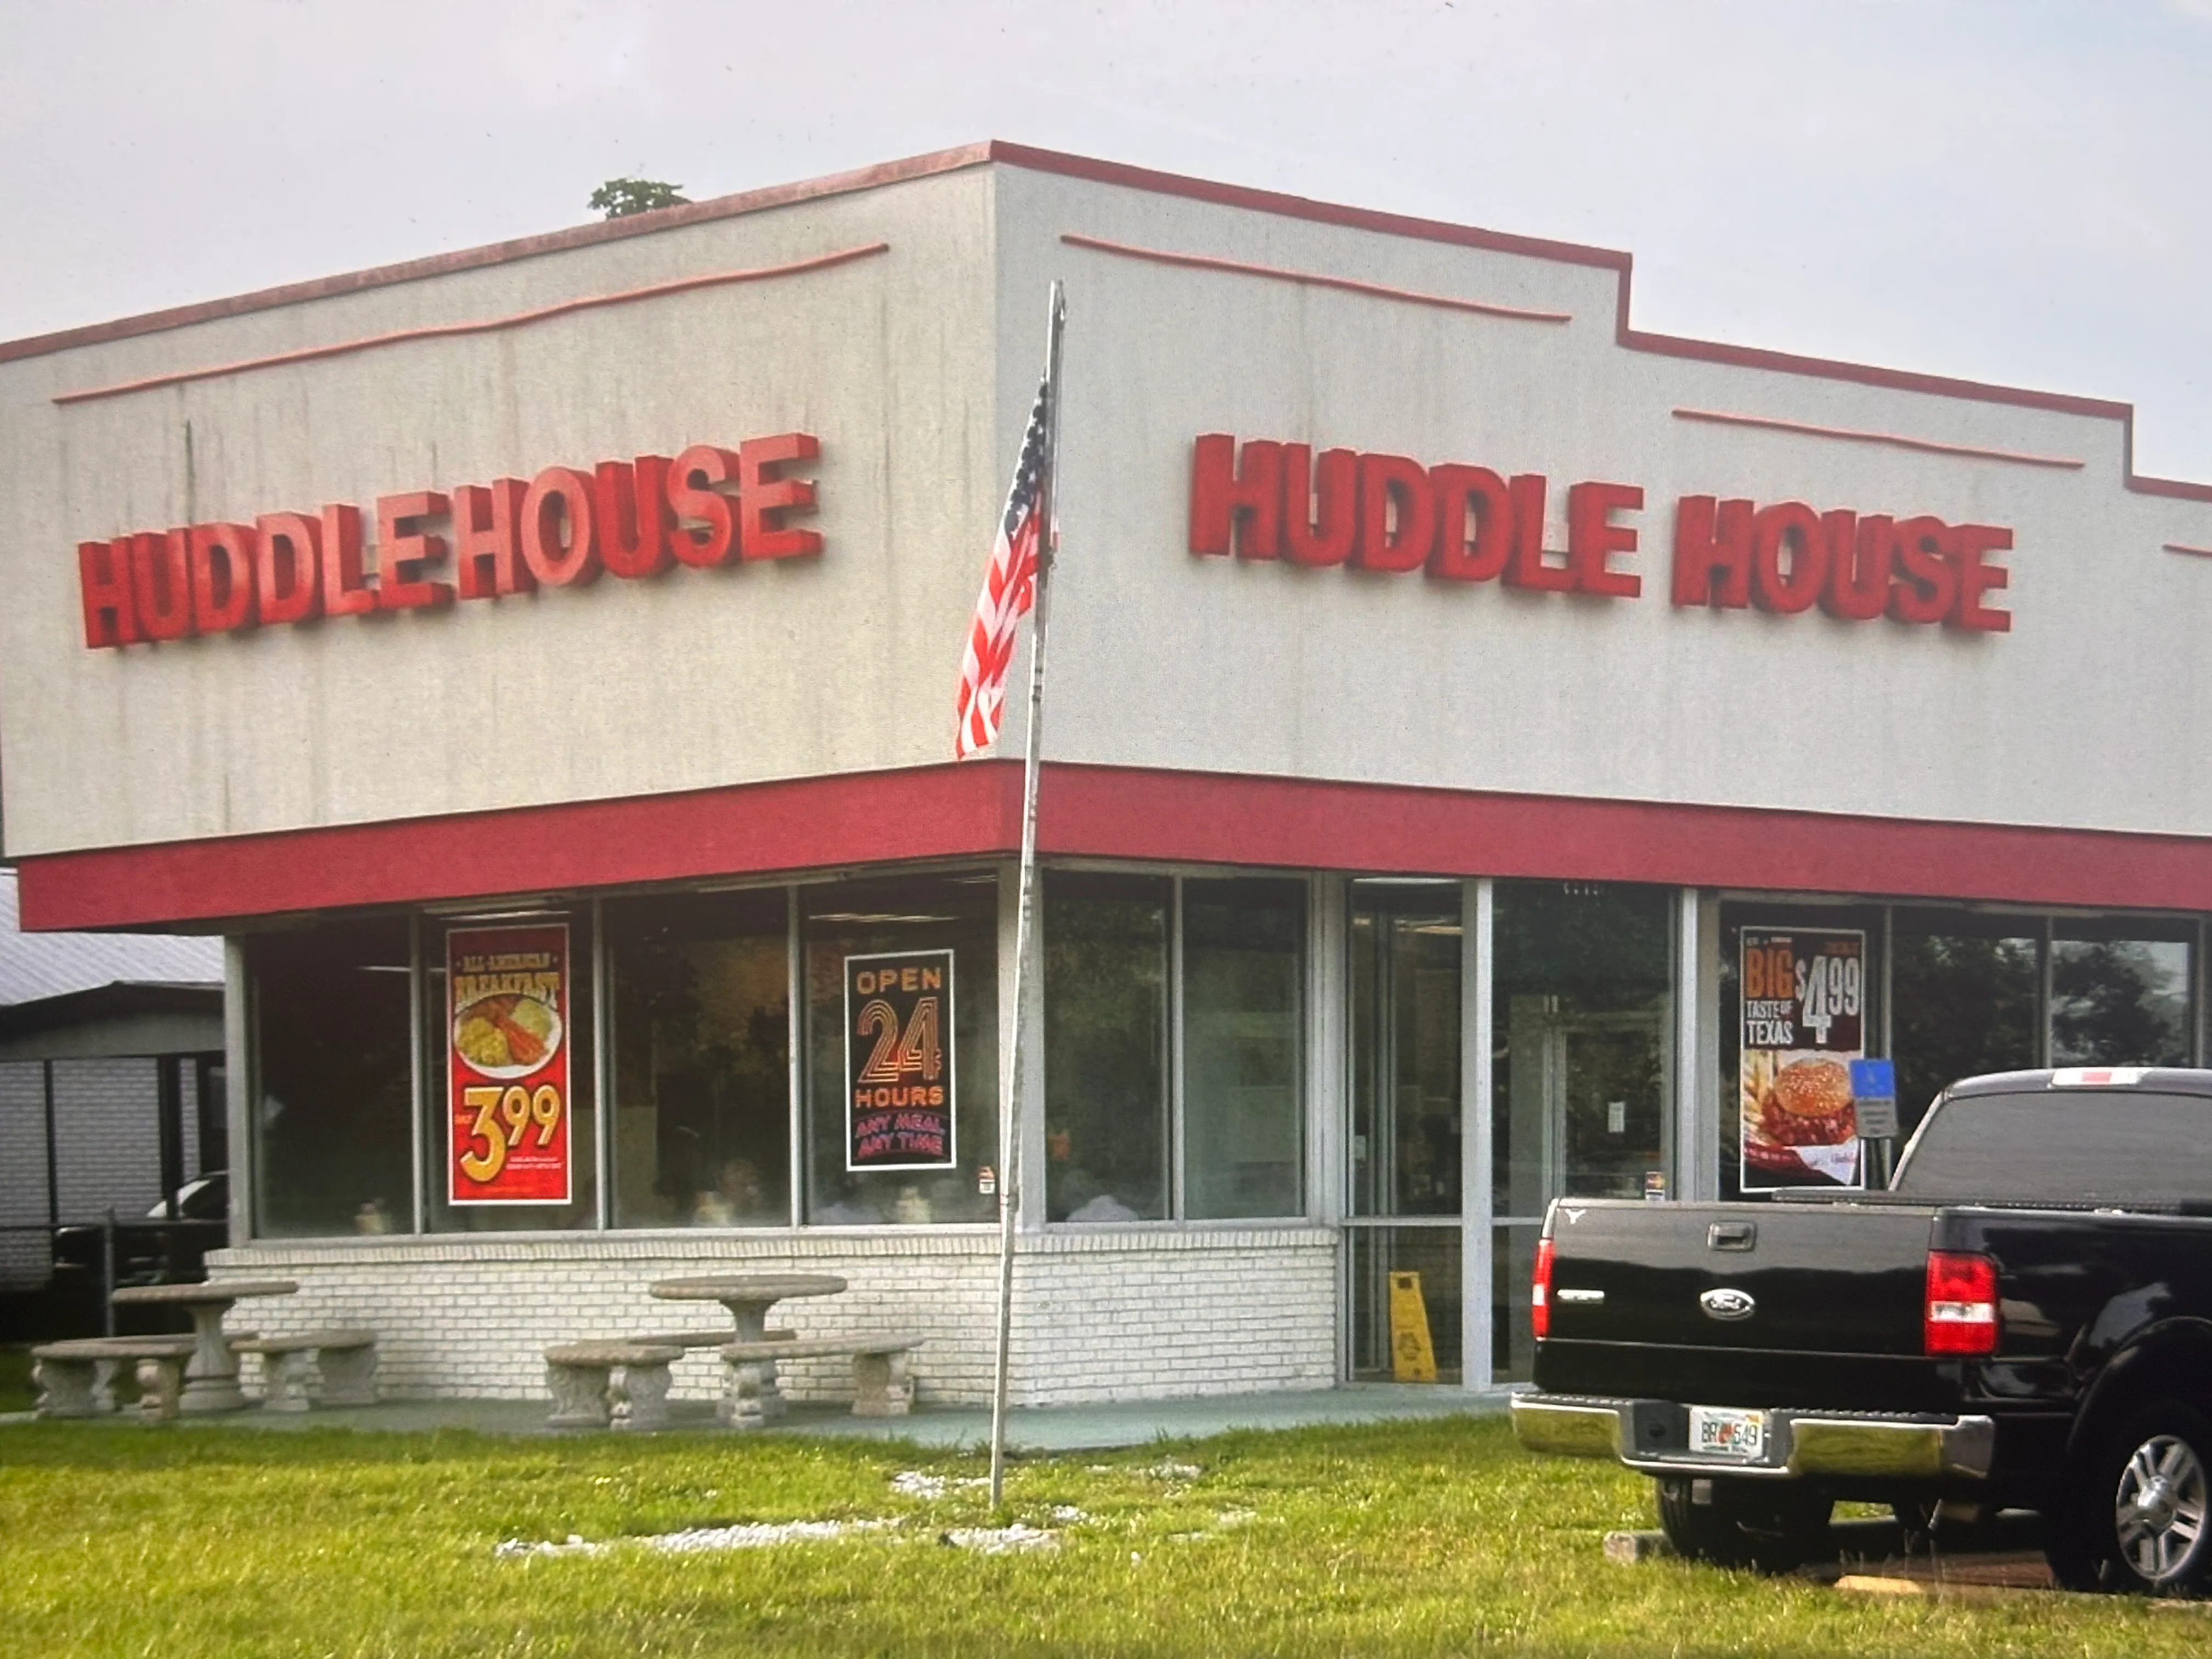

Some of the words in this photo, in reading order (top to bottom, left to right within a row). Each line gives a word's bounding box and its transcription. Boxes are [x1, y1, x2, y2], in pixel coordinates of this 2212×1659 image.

[78, 490, 455, 650] HUDDLE
[454, 432, 823, 601] HOUSE
[1188, 432, 1644, 598] HUDDLE
[1670, 494, 2013, 633] HOUSE
[857, 967, 941, 995] OPEN
[1746, 948, 1794, 998] BIG
[1747, 1001, 1780, 1019] TASTE
[856, 996, 941, 1084] 24
[1746, 1021, 1793, 1045] TEXAS
[855, 1086, 944, 1108] HOURS
[460, 1085, 561, 1182] 399
[854, 1114, 891, 1138] ANY
[894, 1112, 946, 1136] MEAL
[857, 1132, 895, 1159] ANY
